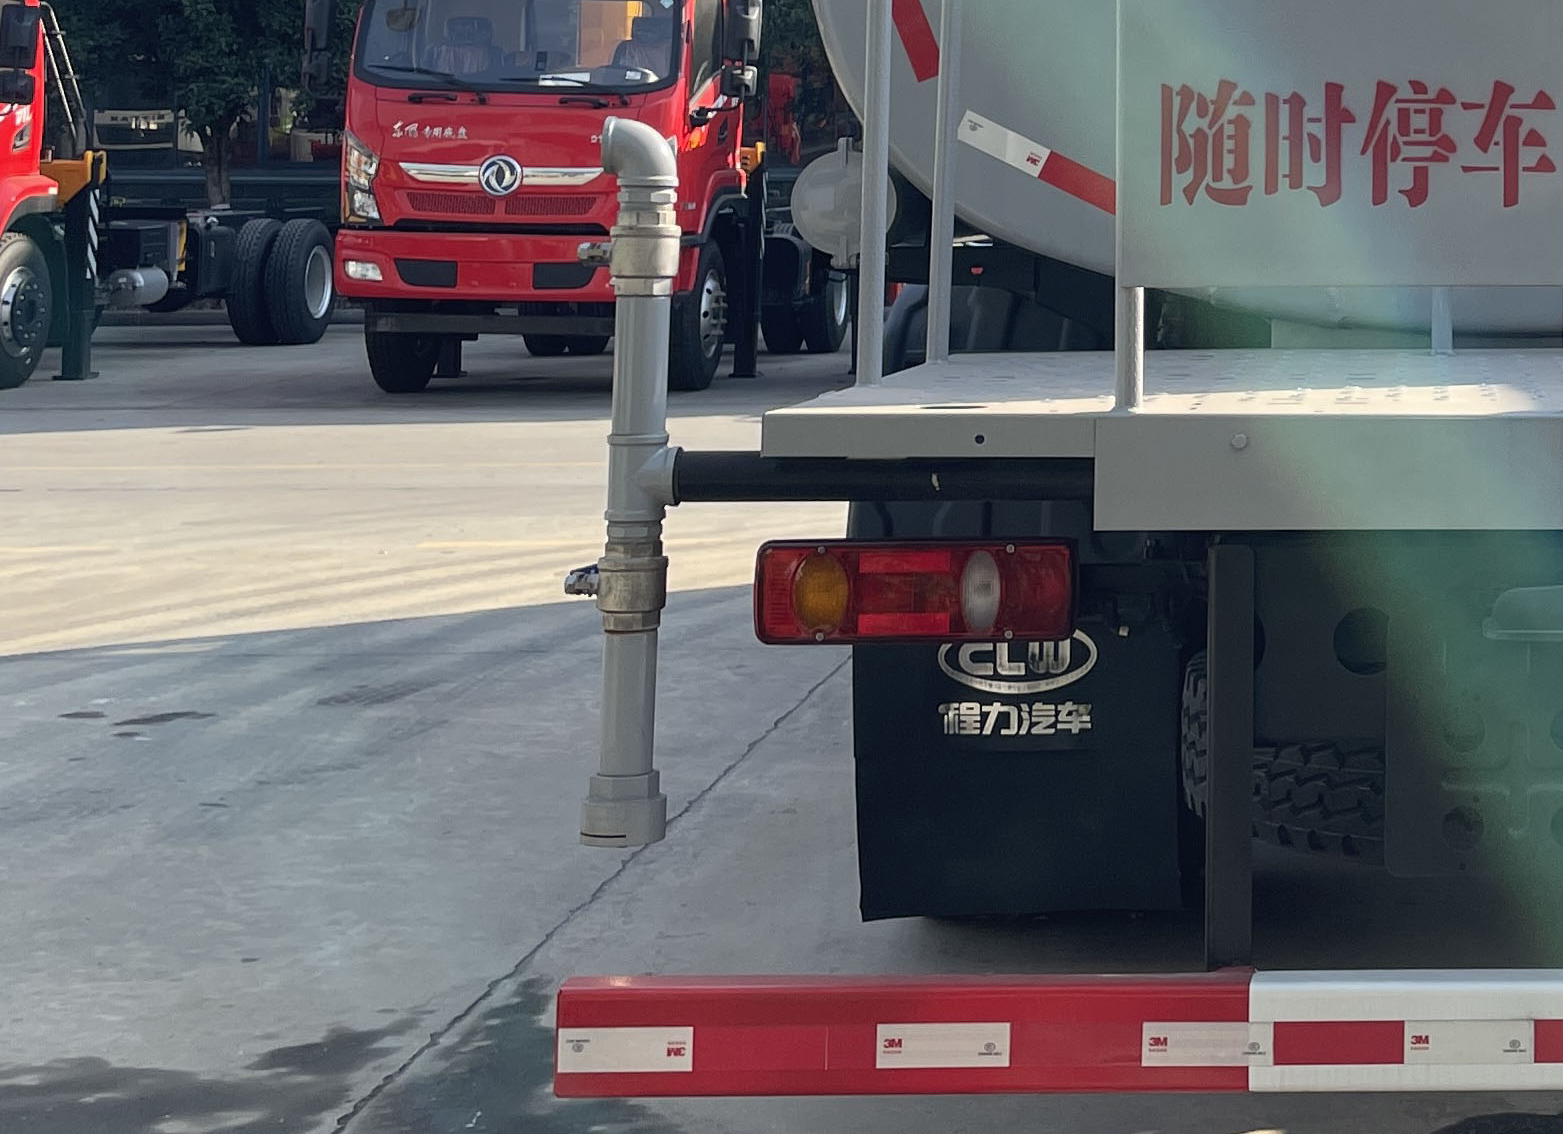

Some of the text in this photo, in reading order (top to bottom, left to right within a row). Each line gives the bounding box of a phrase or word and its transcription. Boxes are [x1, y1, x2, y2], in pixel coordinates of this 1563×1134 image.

[1159, 79, 1557, 209] 随时停车
[957, 642, 1071, 675] CLW
[940, 701, 1092, 735] 程力汽车
[883, 1038, 902, 1049] 3M
[1149, 1037, 1168, 1046] 3M
[1410, 1035, 1430, 1045] 3M
[667, 1047, 686, 1057] 3M
